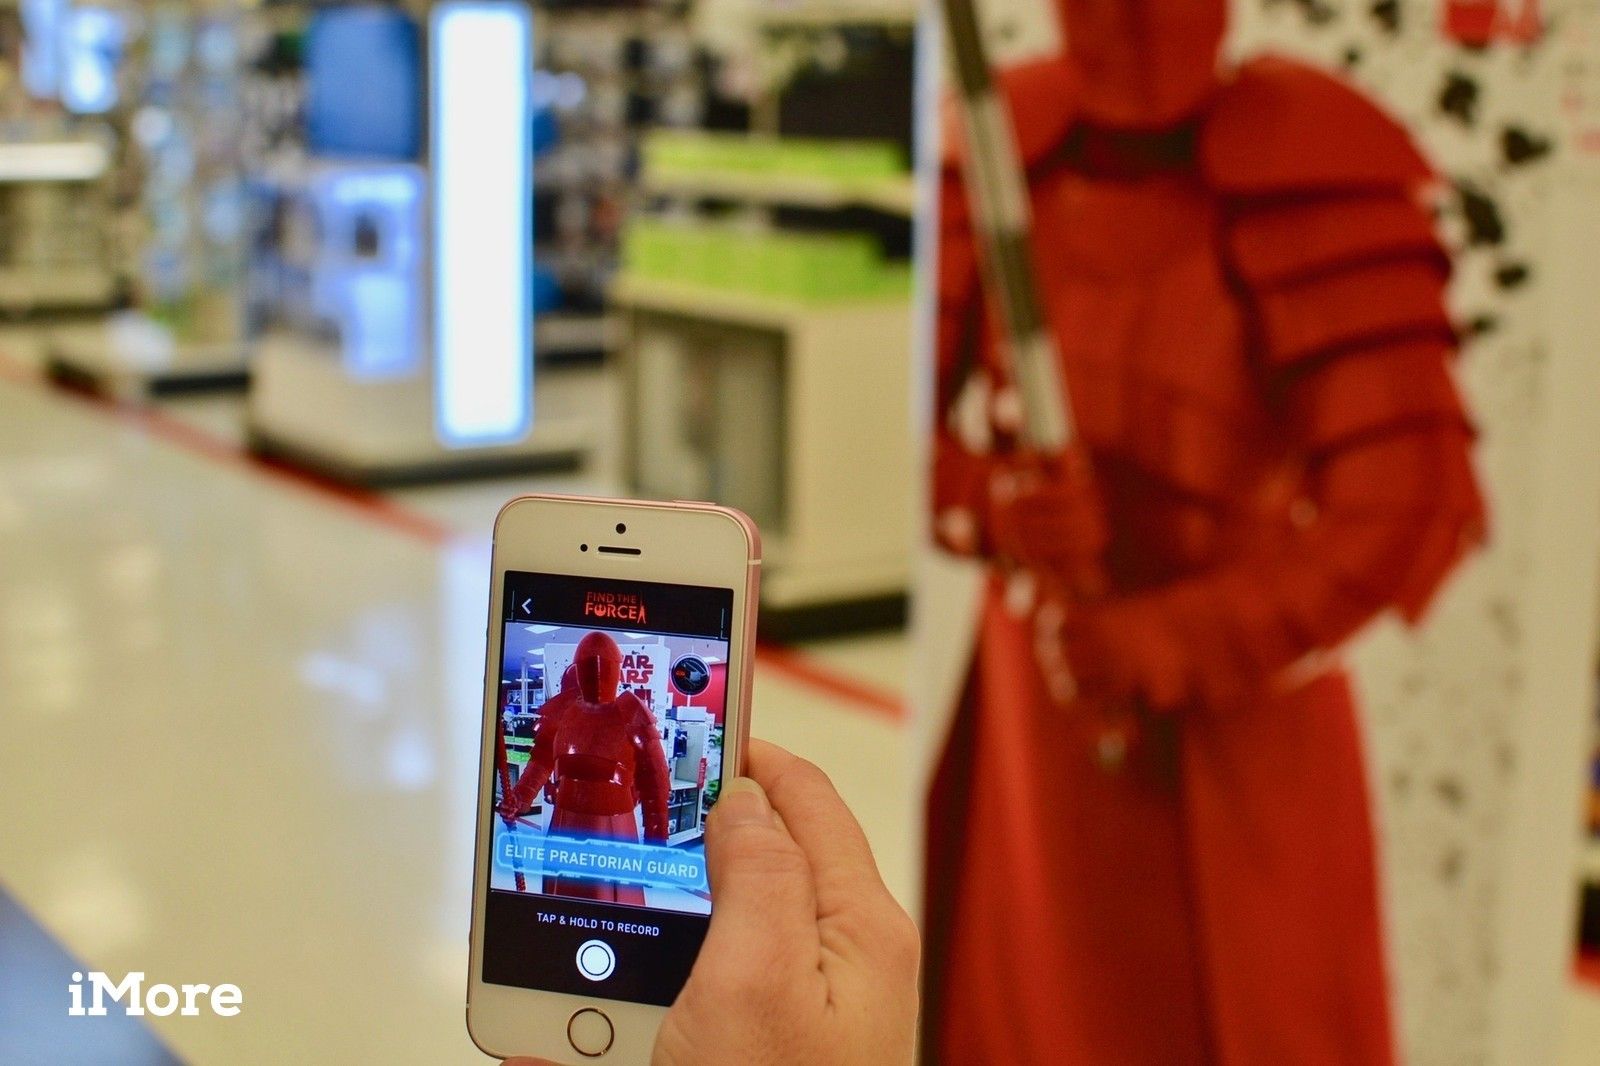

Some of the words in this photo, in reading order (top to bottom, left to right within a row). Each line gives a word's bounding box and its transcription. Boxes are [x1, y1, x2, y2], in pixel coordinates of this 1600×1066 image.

[587, 592, 615, 603] FIND
[616, 594, 637, 604] THE
[505, 844, 545, 861] ELITE
[550, 849, 643, 873] PRAETORIAN
[647, 860, 698, 879] GUARD
[537, 912, 556, 923] TAP
[559, 915, 566, 925] &
[569, 916, 598, 929] HOLD
[601, 920, 614, 931] TO
[617, 922, 660, 937] RECORD
